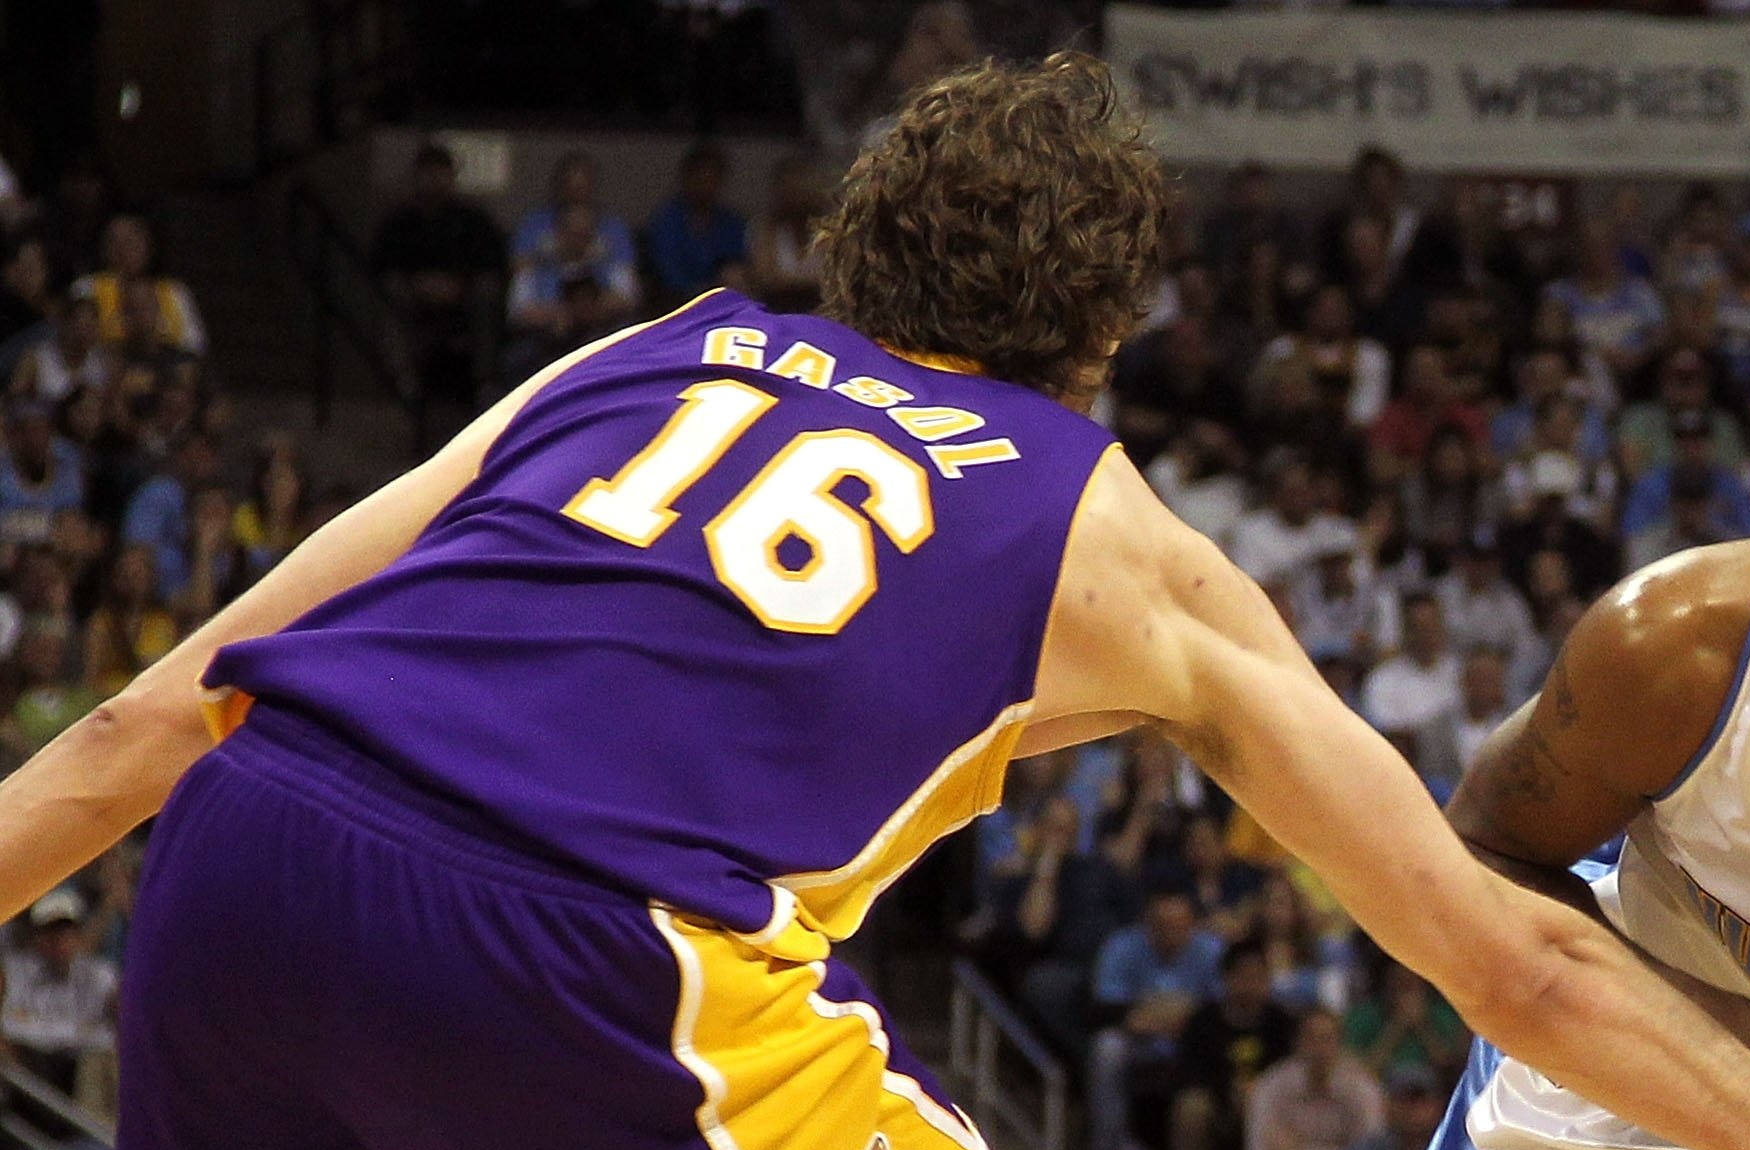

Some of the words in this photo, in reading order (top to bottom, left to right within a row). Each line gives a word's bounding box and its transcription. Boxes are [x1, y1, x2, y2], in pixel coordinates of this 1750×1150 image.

[1456, 62, 1742, 122] WISHES
[702, 327, 1022, 479] GASOL
[560, 379, 935, 634] 16
